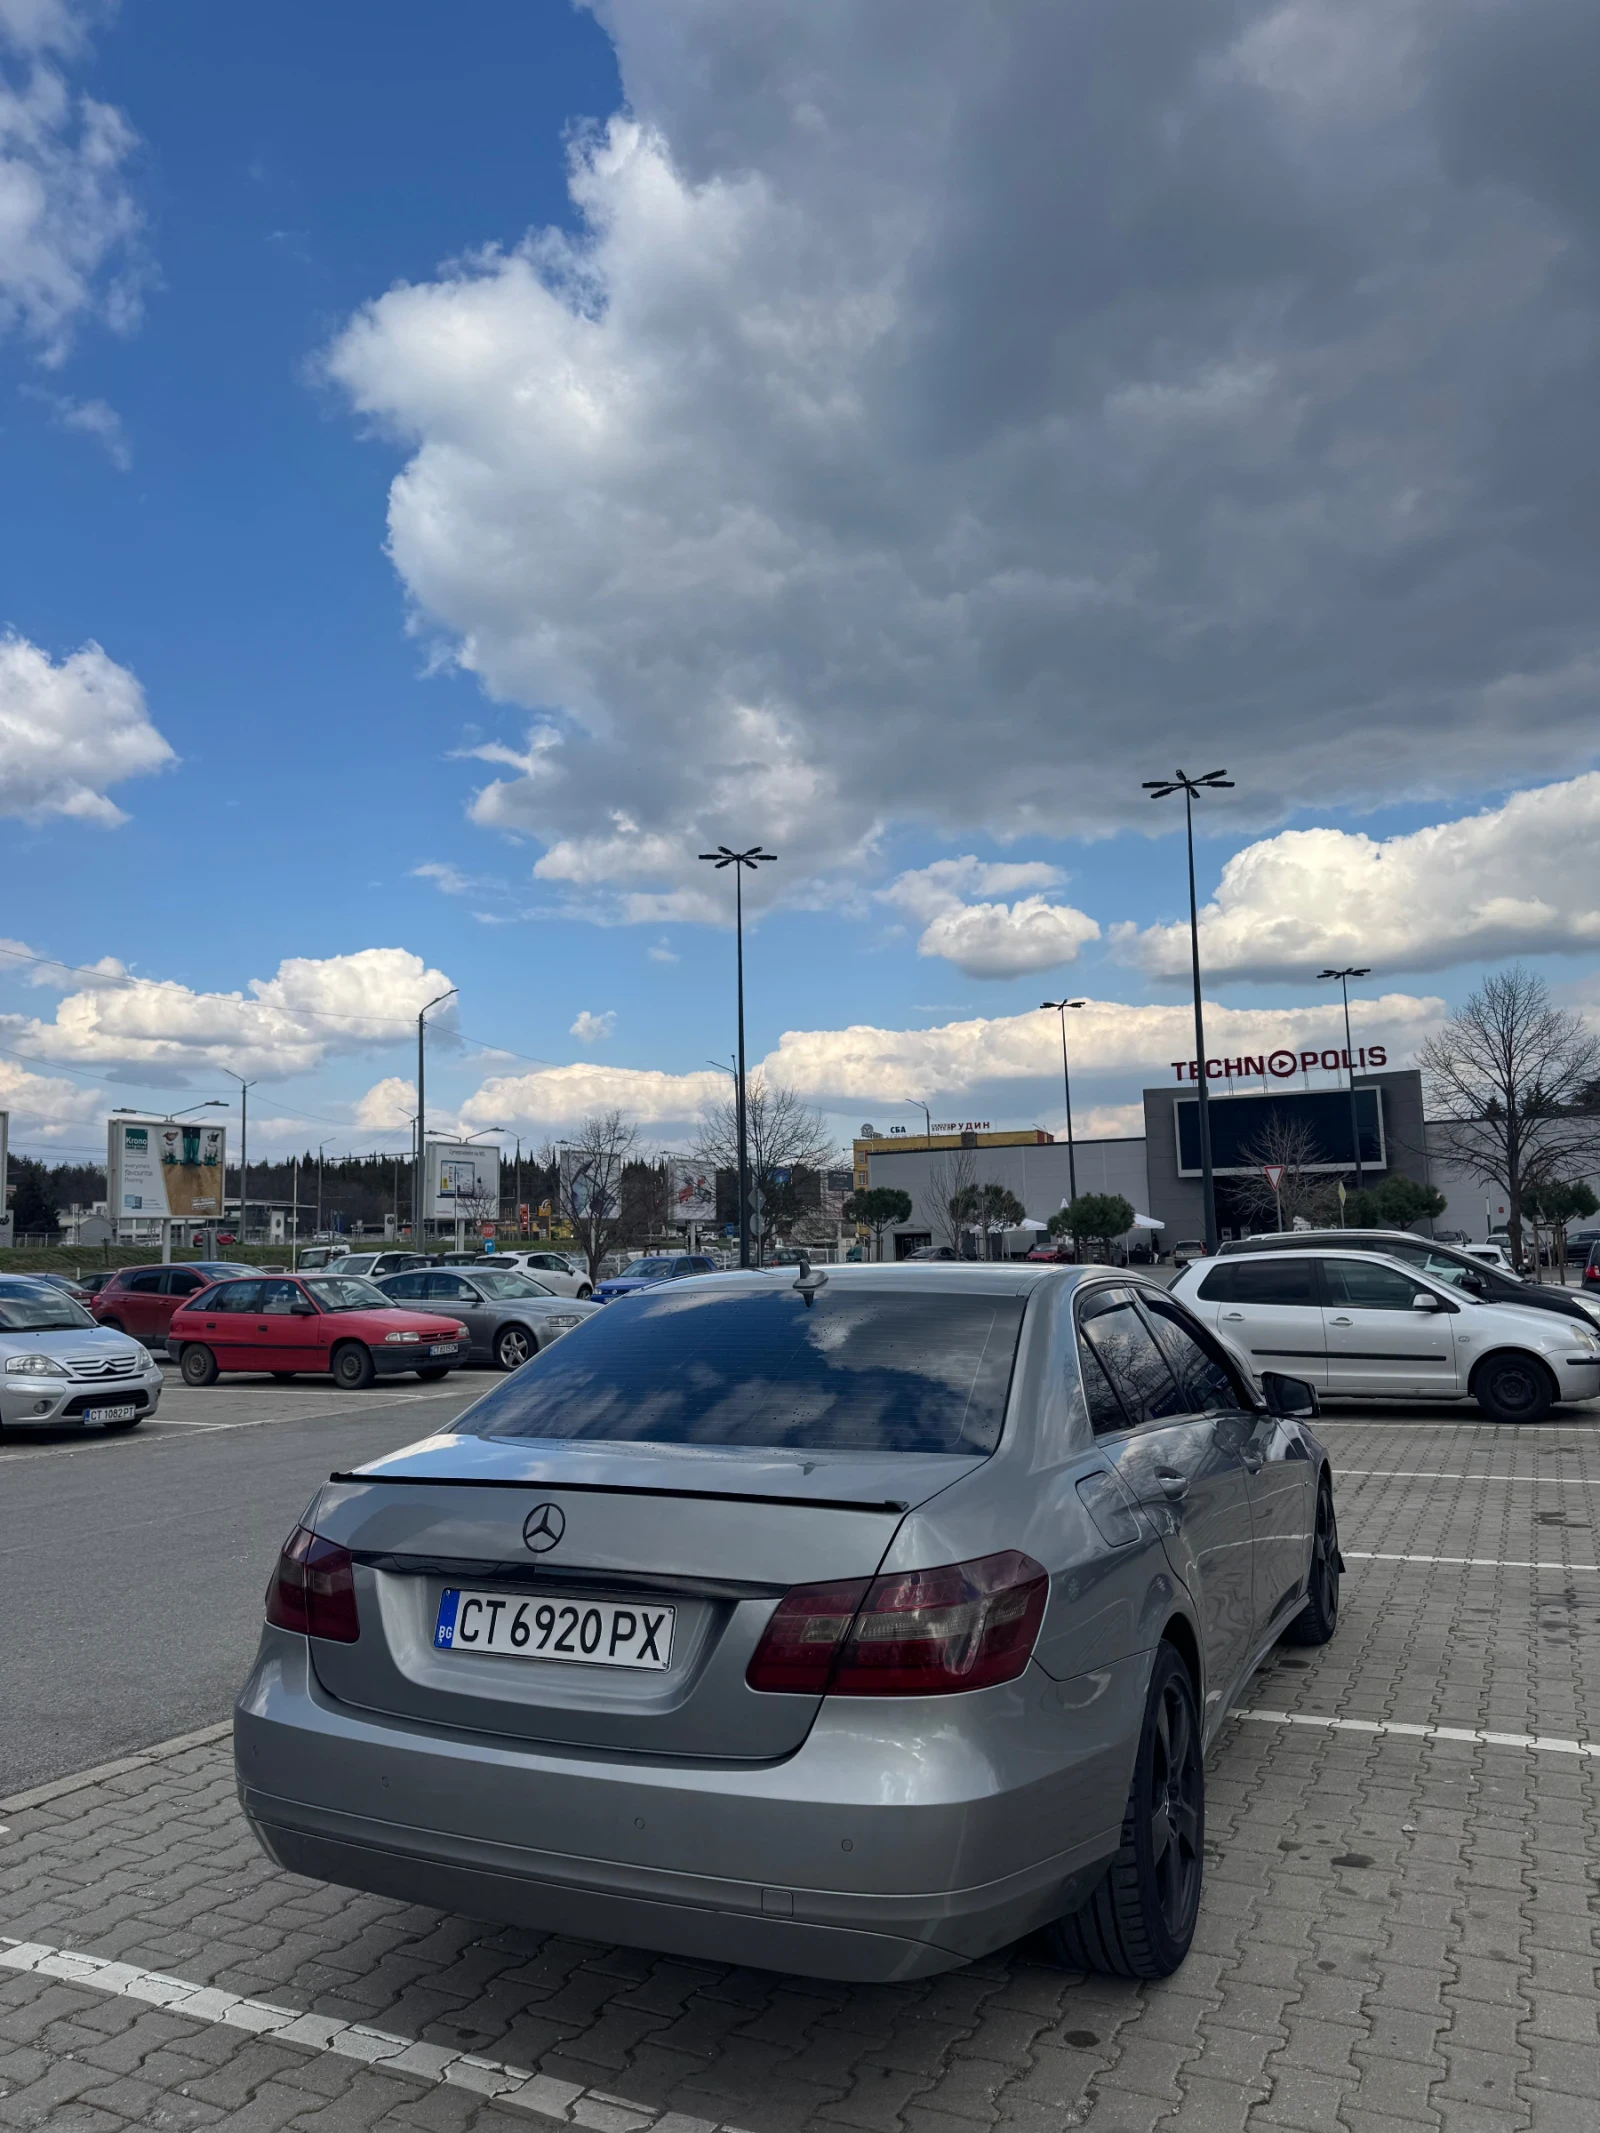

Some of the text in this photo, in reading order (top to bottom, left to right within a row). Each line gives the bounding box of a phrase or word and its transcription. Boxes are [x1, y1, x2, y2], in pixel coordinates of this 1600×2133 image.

[1171, 1046, 1387, 1081] TECHNOPOLIS
[890, 1126, 906, 1134] СБА
[91, 1407, 134, 1420] CT 1082 PT
[438, 1625, 453, 1640] BG
[459, 1599, 666, 1661] CT 6920 PX
